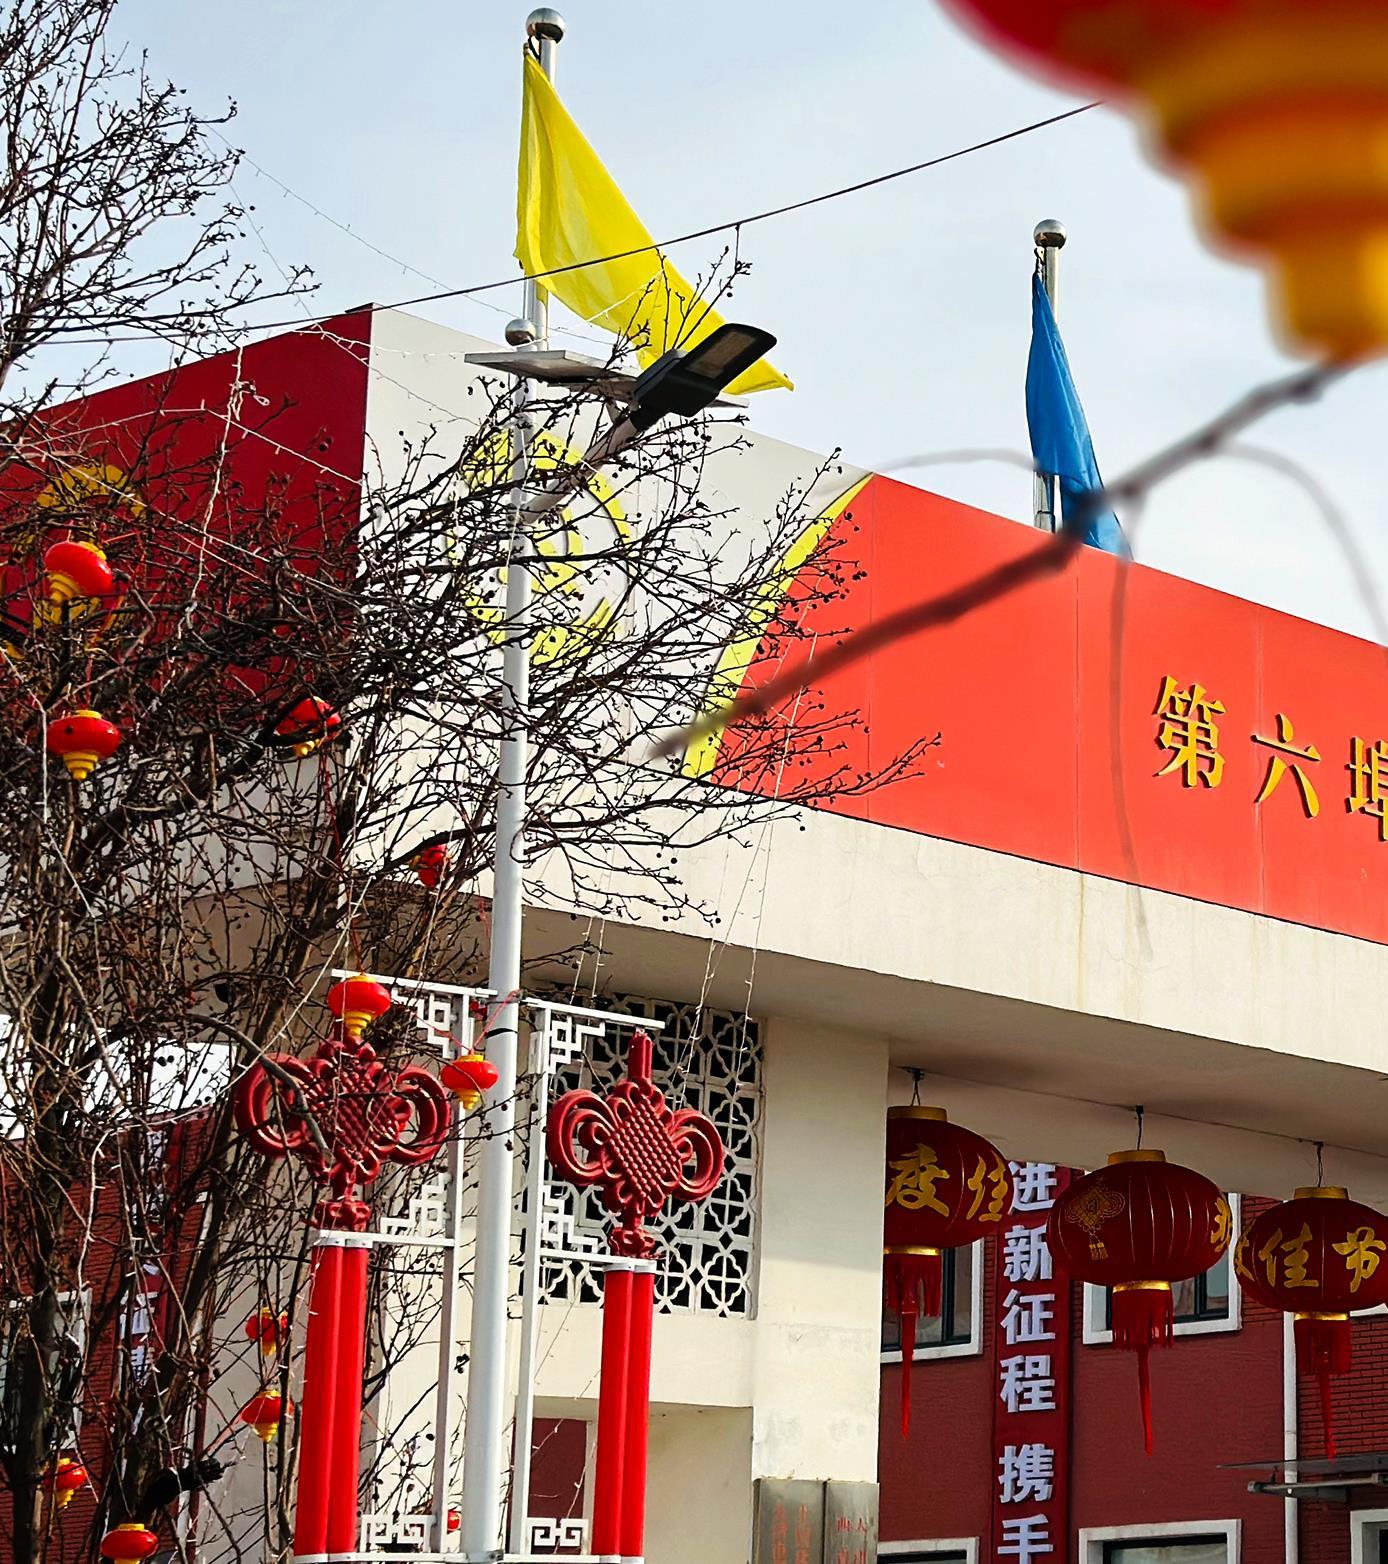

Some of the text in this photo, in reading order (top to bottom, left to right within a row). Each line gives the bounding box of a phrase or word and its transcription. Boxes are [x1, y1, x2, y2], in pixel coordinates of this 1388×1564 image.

[998, 1161, 1057, 1564] 进新征程 携手
